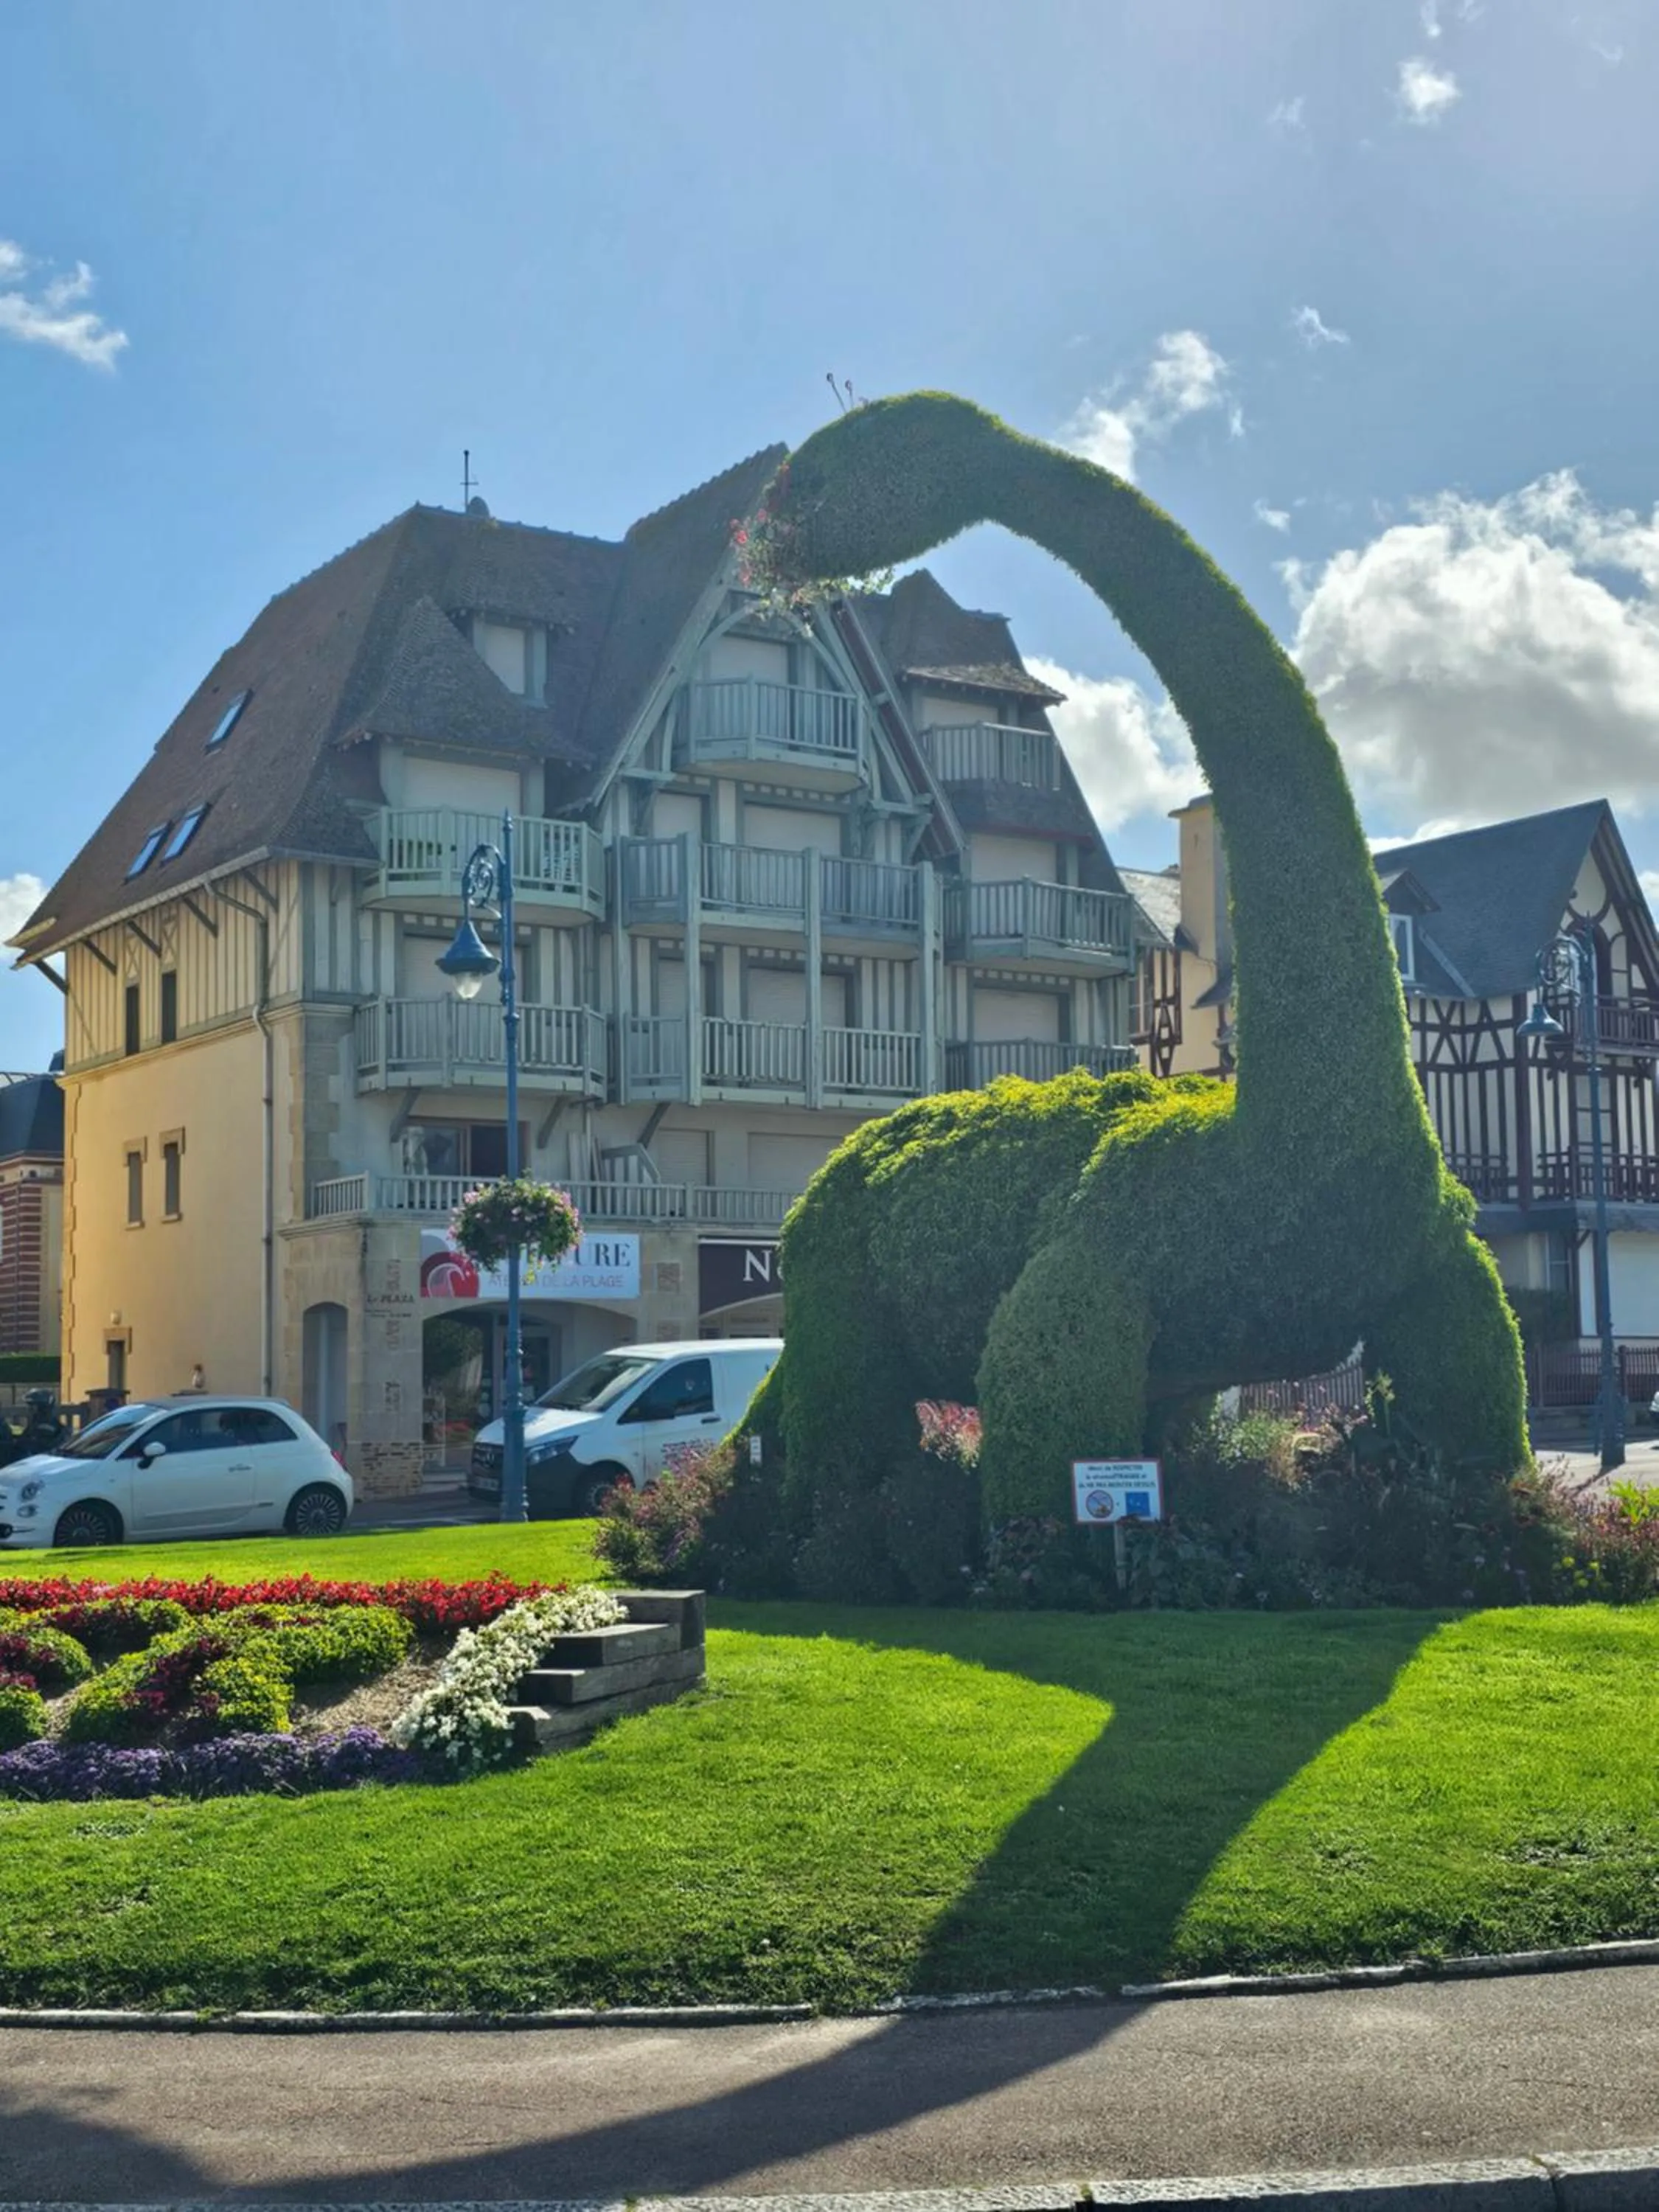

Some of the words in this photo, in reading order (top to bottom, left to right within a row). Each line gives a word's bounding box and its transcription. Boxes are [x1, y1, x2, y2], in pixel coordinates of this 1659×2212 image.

[542, 1275, 561, 1287] DE
[564, 1275, 580, 1287] LA
[582, 1274, 625, 1287] PLAGE
